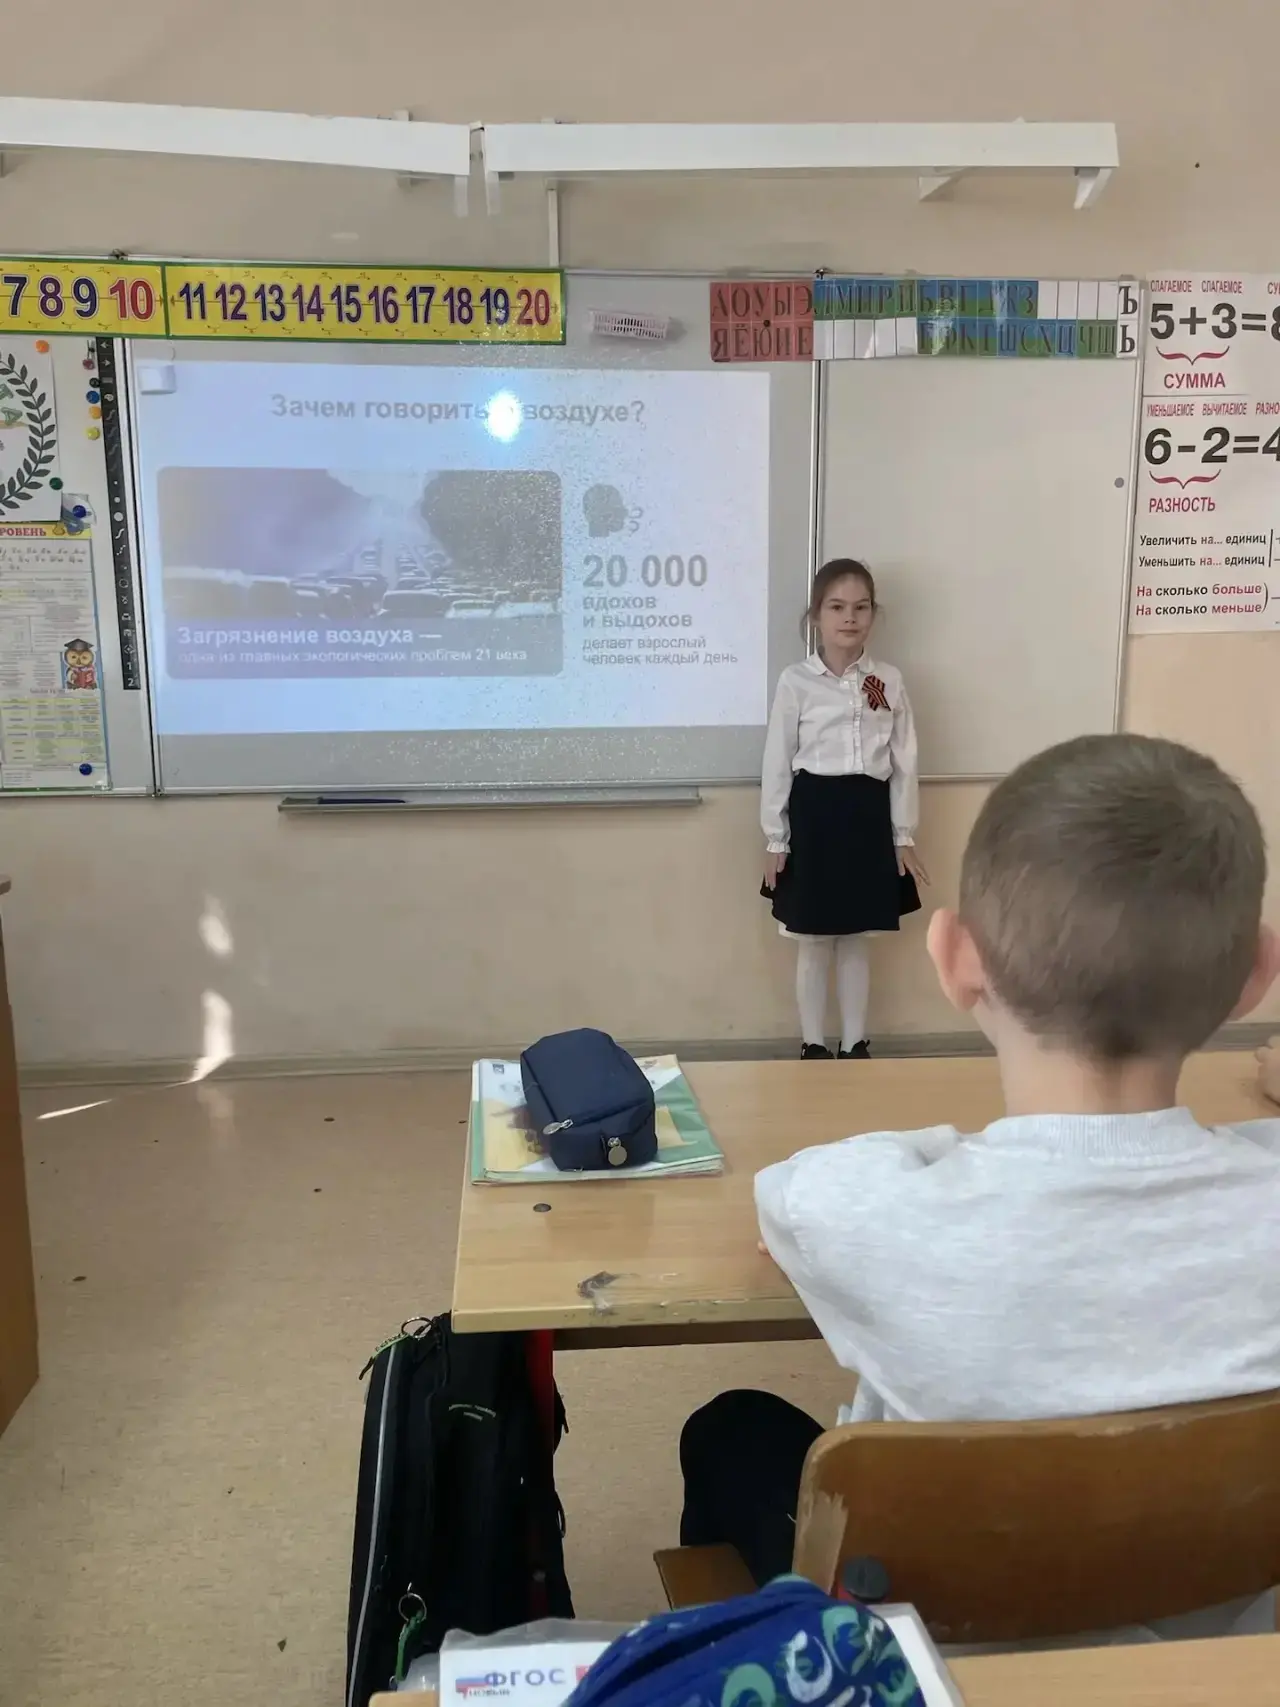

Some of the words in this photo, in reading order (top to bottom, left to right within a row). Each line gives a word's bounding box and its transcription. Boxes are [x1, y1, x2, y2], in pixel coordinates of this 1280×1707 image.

[1150, 280, 1192, 293] СЛАГАЕМОЕ
[1201, 280, 1243, 294] СЛАГАЕМОЕ
[1267, 282, 1280, 295] СУ
[3, 276, 28, 316] 7
[40, 276, 64, 317] 8
[73, 277, 98, 318] 9
[110, 279, 154, 321] 10
[180, 283, 206, 320] 11
[216, 284, 248, 321] 12
[255, 284, 286, 322] 13
[292, 285, 325, 322] 14
[331, 285, 362, 323] 15
[369, 286, 400, 324] 16
[406, 286, 436, 324] 17
[444, 287, 473, 325] 18
[480, 287, 510, 325] 19
[517, 288, 550, 326] 20
[1163, 373, 1226, 390] СУММА
[271, 394, 356, 418] Зачем
[523, 401, 646, 426] воздухе?
[1146, 403, 1194, 417] УМЕНЬШАЕМОЕ
[1201, 403, 1247, 416] ВЫЧИТАЕМОЕ
[1149, 497, 1216, 513] РАЗНОСТЬ
[1140, 535, 1197, 546] Увеличить
[1225, 535, 1267, 546] единиц
[1139, 556, 1196, 567] Уменьшить
[1224, 556, 1265, 567] единиц
[582, 554, 628, 588] 20
[641, 554, 708, 588] 000
[1136, 586, 1152, 597] На
[1155, 586, 1208, 596] сколько
[1212, 584, 1261, 595] больше
[582, 596, 657, 612] вдохов
[1136, 605, 1151, 616] На
[1155, 605, 1207, 615] сколько
[1212, 604, 1262, 614] меньше
[583, 616, 596, 627] и
[602, 614, 693, 629] выдохов
[177, 627, 319, 648] Загрязнение
[327, 629, 413, 647] воздуха
[582, 638, 634, 651] делает
[638, 636, 706, 652] взрослый
[240, 652, 298, 663] главных
[304, 651, 407, 663] экологических
[411, 648, 472, 663] проблем
[475, 648, 491, 660] 21
[582, 654, 641, 665] человек
[645, 653, 700, 665] каждый
[703, 653, 738, 665] день
[485, 1668, 567, 1687] ФГОС
